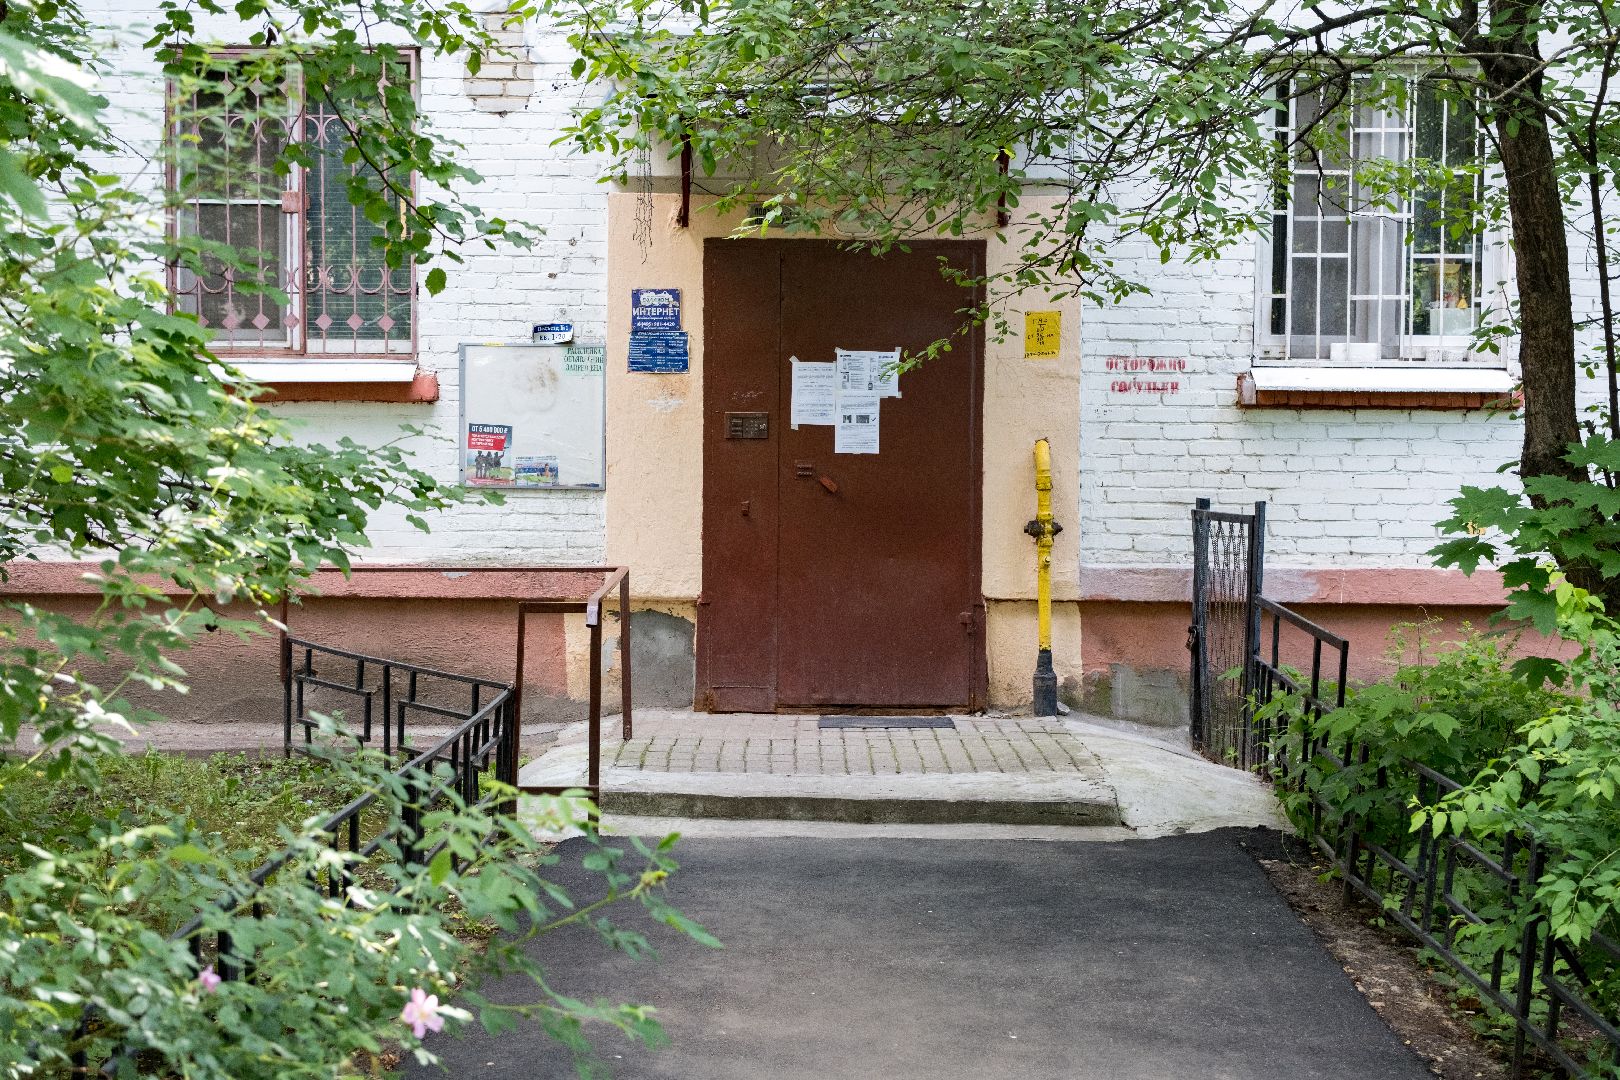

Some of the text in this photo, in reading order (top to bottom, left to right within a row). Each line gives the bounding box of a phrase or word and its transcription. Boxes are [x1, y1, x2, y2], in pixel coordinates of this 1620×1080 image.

[632, 307, 680, 316] ИНТЕРНЕТ
[1106, 357, 1186, 371] ОСТОРОЖНО
[1110, 380, 1179, 393] СОСУЛЬКИ
